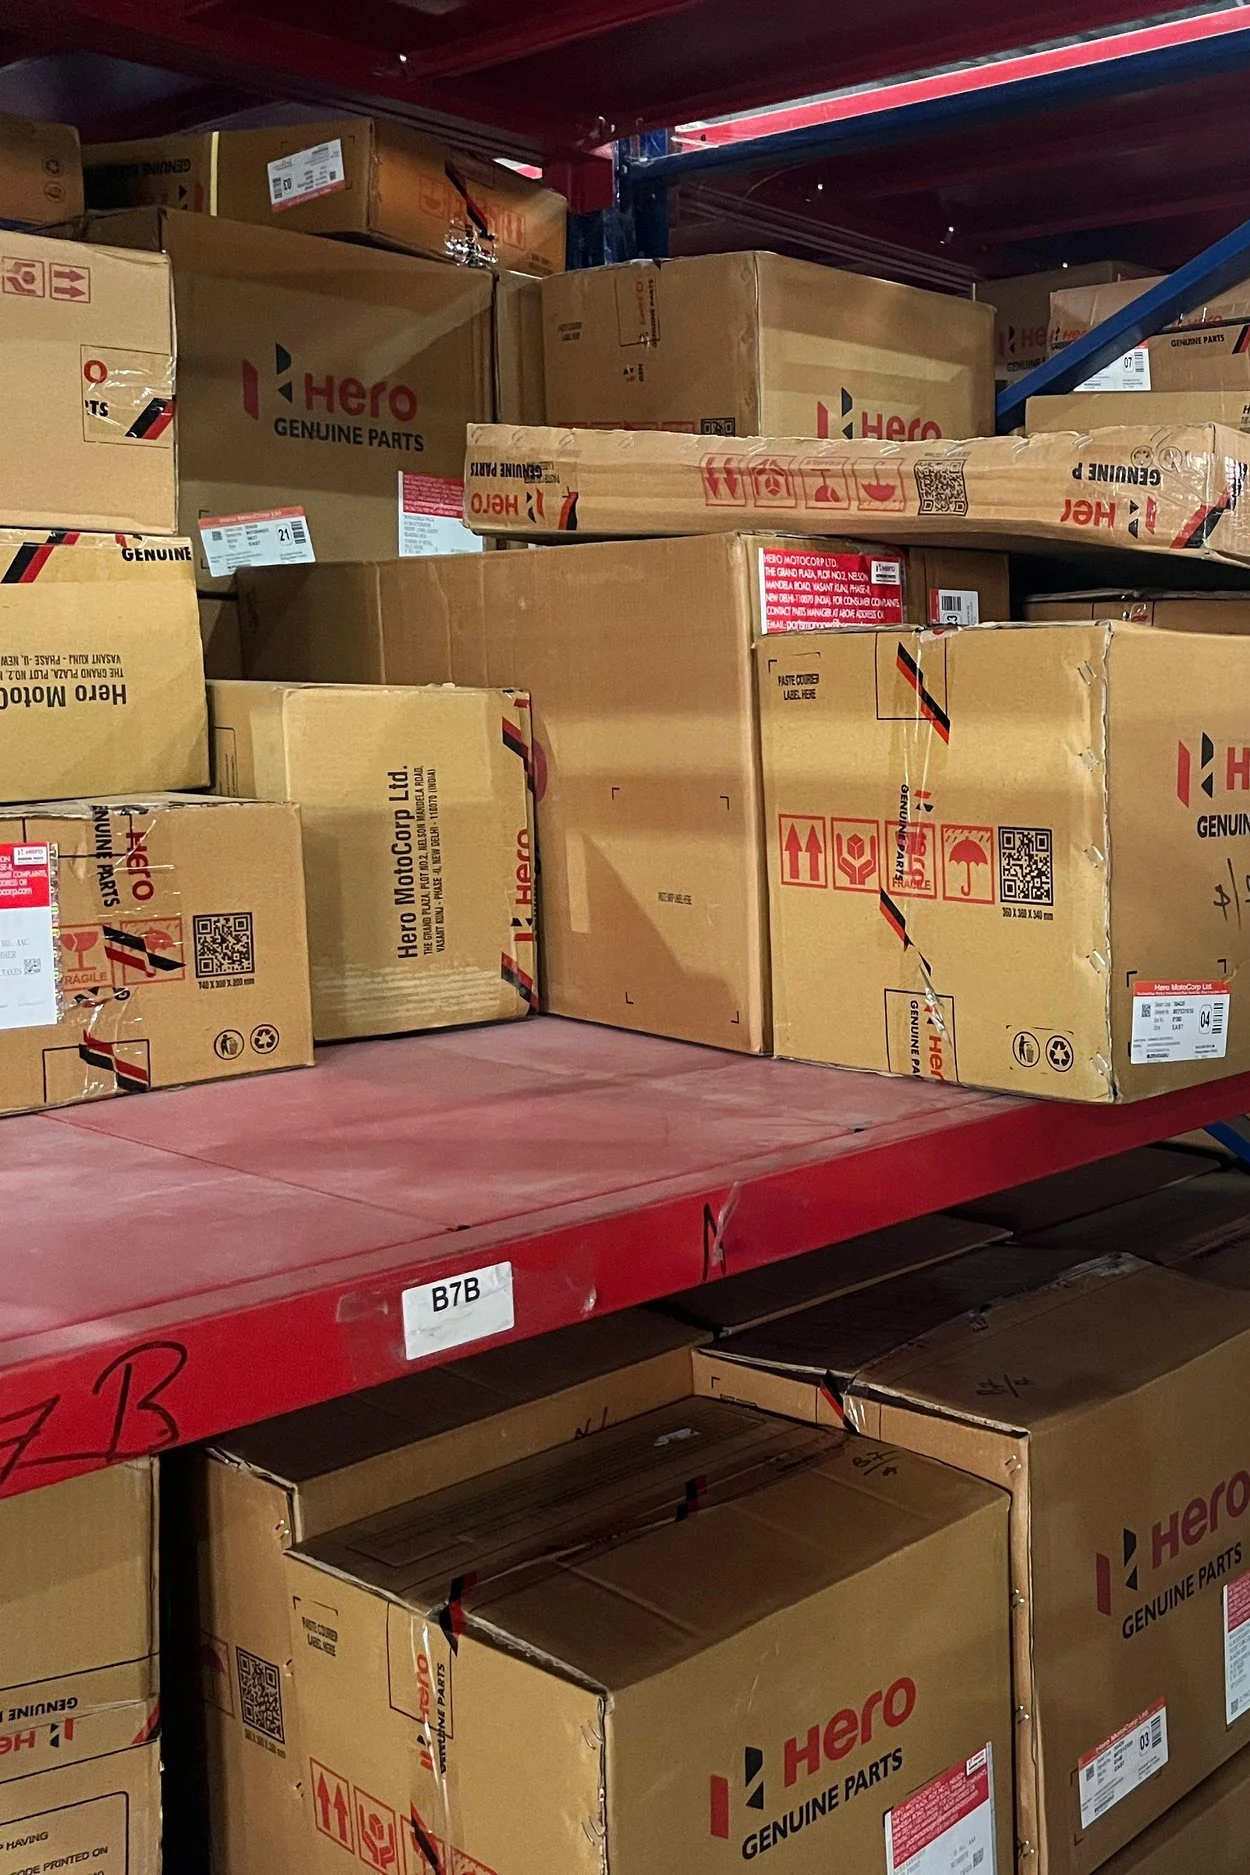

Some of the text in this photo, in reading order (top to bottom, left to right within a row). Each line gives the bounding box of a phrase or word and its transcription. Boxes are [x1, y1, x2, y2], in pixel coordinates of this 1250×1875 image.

[1171, 334, 1225, 348] GENUINE PARTS
[304, 372, 418, 422] Hero
[274, 418, 424, 452] GENUINE PARTS
[471, 463, 543, 479] GENUINE PARTS
[1089, 464, 1161, 486] GENUINE
[471, 492, 519, 516] Hero
[278, 528, 291, 542] 21
[122, 546, 192, 563] GENUINE
[764, 553, 839, 567] HERO MOTOCORP LTD.
[29, 669, 49, 680] PLOT
[81, 668, 107, 679] GRAND
[110, 668, 124, 678] THE
[778, 674, 795, 686] PASTE
[75, 684, 127, 705] Hero
[895, 784, 909, 882] GENUINE PARTS
[126, 831, 154, 901] Hero
[387, 765, 418, 959] Hero MotoCorp Ltd.
[97, 865, 120, 907] PARTS
[1154, 983, 1170, 991] Hero
[1171, 983, 1201, 992] MotoCorp
[911, 1000, 919, 1055] GENUINE
[1200, 1011, 1210, 1028] 04
[431, 1277, 480, 1312] B7B
[1151, 1470, 1250, 1569] Hero
[1121, 1574, 1196, 1640] GENUINE
[1199, 1542, 1242, 1594] PARTS
[437, 1662, 446, 1707] PARTS
[8, 1697, 78, 1721] GENUINE
[783, 1676, 917, 1788] Hero
[1139, 1731, 1150, 1751] 03
[741, 1777, 841, 1861] GENUINE
[844, 1747, 903, 1804] PARTS
[6, 1831, 49, 1851] HAVING
[43, 1852, 89, 1872] PRINTED
[92, 1846, 108, 1857] ON
